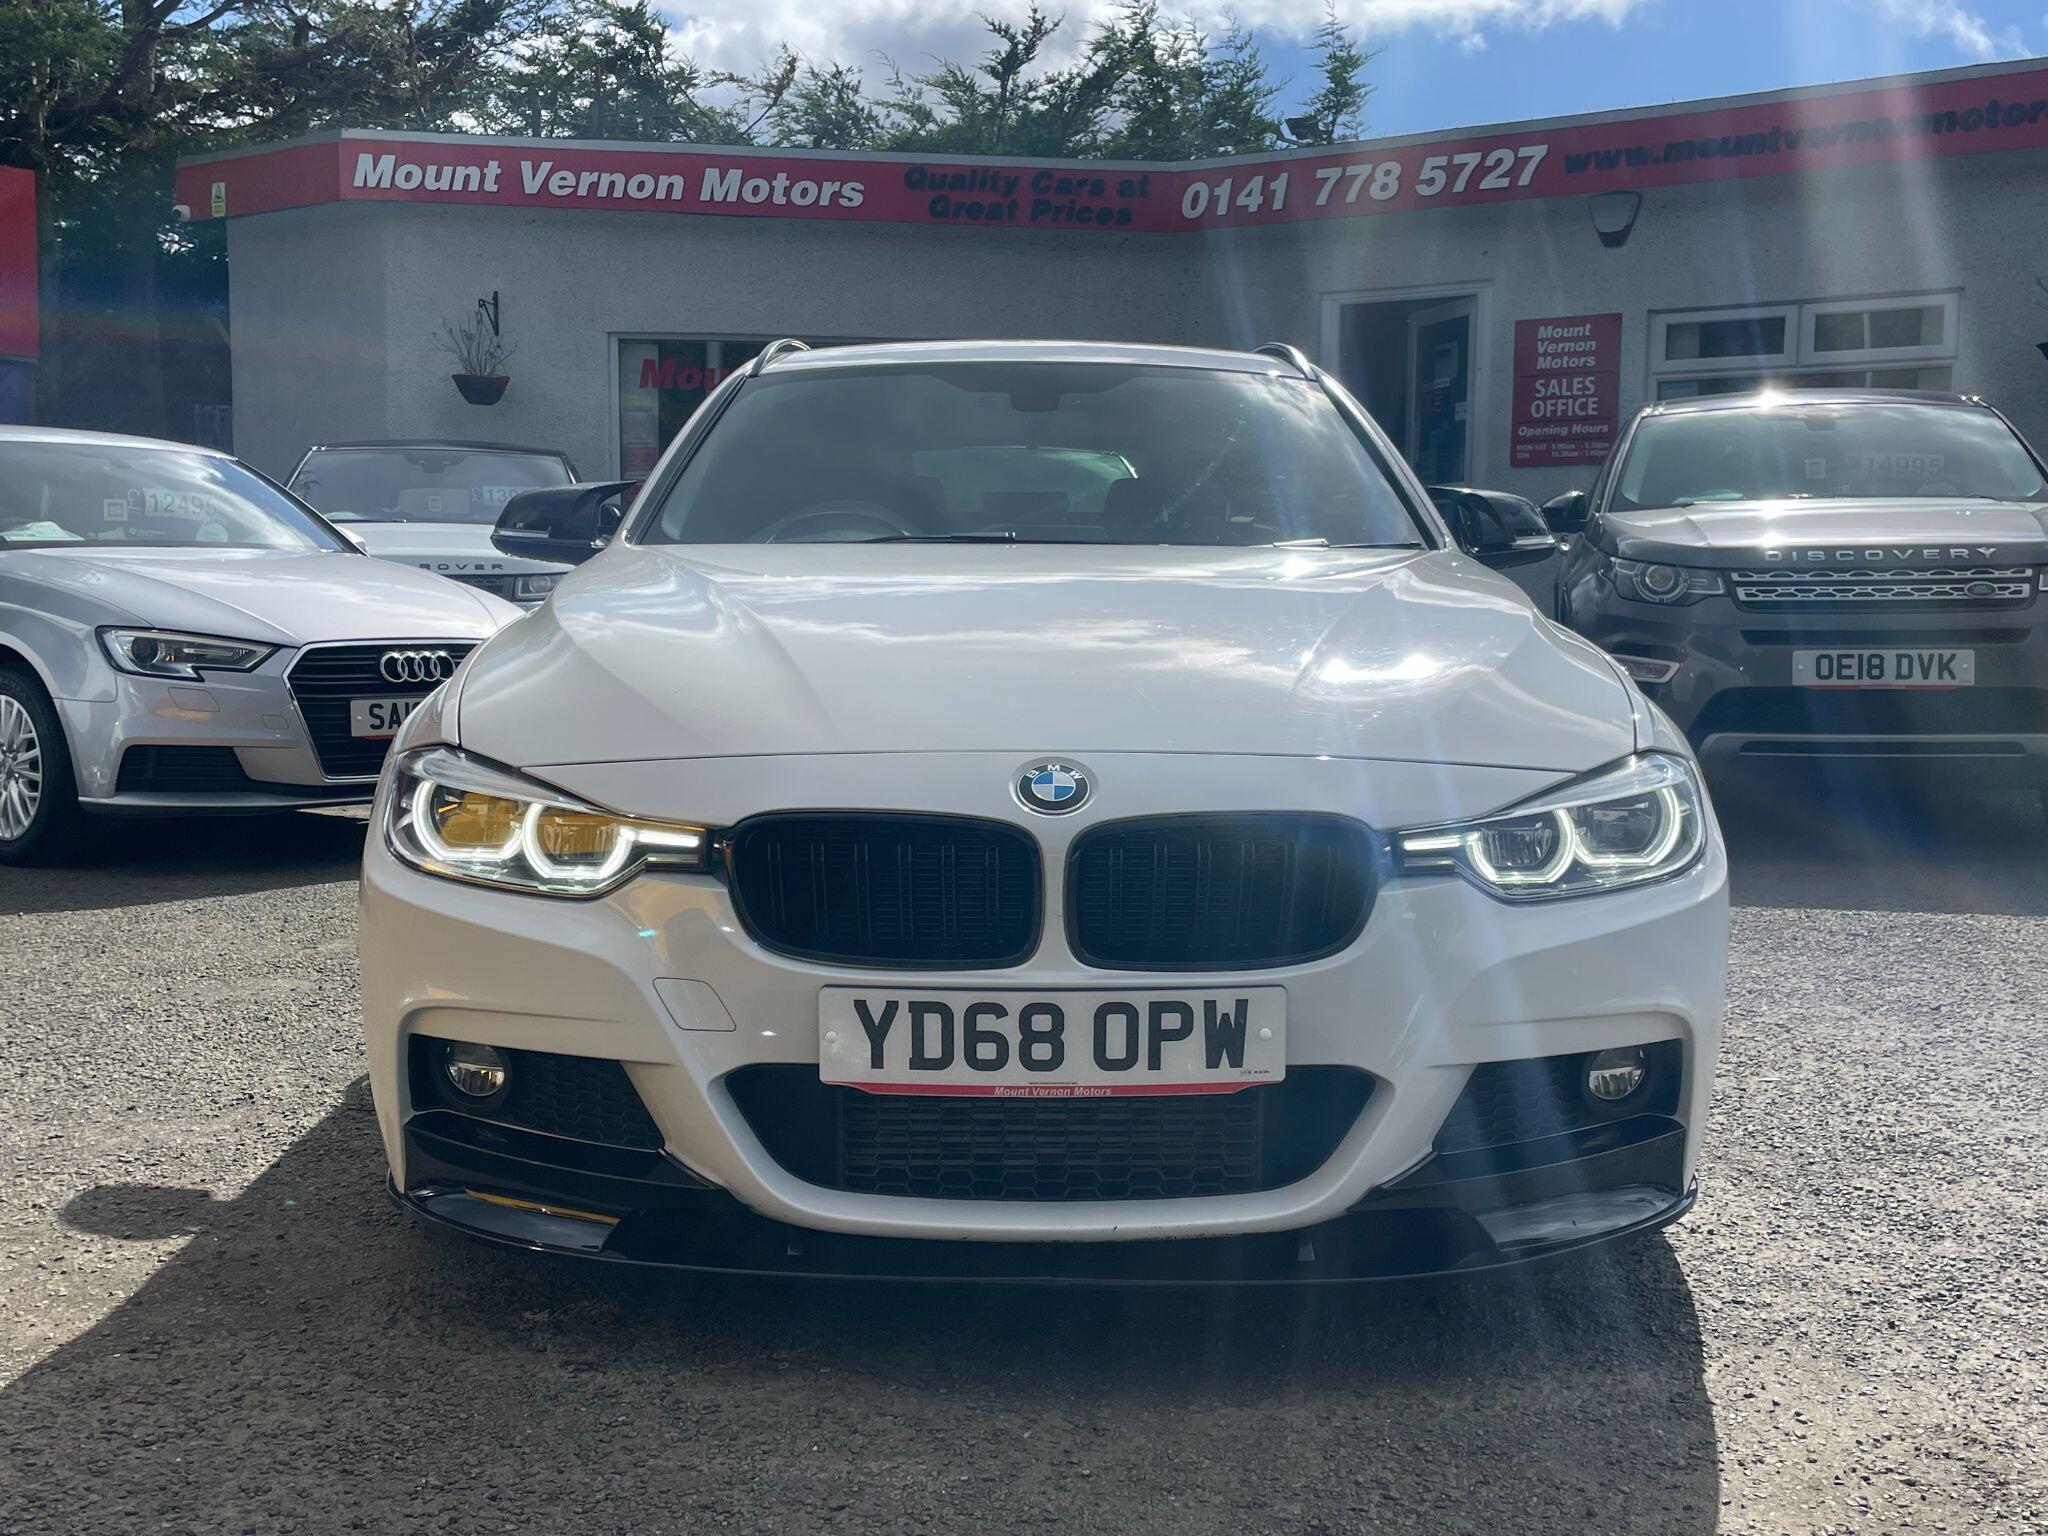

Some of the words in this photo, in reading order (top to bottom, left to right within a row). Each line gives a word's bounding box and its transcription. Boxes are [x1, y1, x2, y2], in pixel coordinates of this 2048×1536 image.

[1563, 99, 2048, 174] www.mountvernomotor
[353, 153, 501, 193] Mount
[520, 160, 685, 200] Vernon
[700, 168, 866, 208] Motors
[904, 165, 1020, 198] Quality
[1031, 170, 1106, 196] Cars
[1117, 174, 1150, 198] at
[1182, 173, 1290, 219] 0141
[1315, 161, 1401, 207] 778
[1415, 145, 1549, 195] 5727
[929, 194, 1019, 221] Great
[1030, 198, 1133, 225] Prices
[1537, 323, 1592, 339] Mount
[1536, 340, 1597, 354] Vernon
[1536, 355, 1597, 370] Motors
[1535, 376, 1596, 398] SALES
[1530, 397, 1599, 418] OFFICE
[1518, 424, 1568, 438] Opening
[1571, 423, 1609, 434] Hours
[1764, 546, 1998, 562] DISCOVERY
[419, 563, 504, 571] ROVER
[1895, 653, 1957, 681] DVK
[369, 702, 421, 730] SA1
[1026, 764, 1083, 780] BMW
[853, 998, 1065, 1073] YD68
[1093, 998, 1250, 1073] OPW
[994, 1086, 1029, 1097] Mount
[1031, 1086, 1071, 1097] Vernon
[1073, 1086, 1112, 1097] Motors
